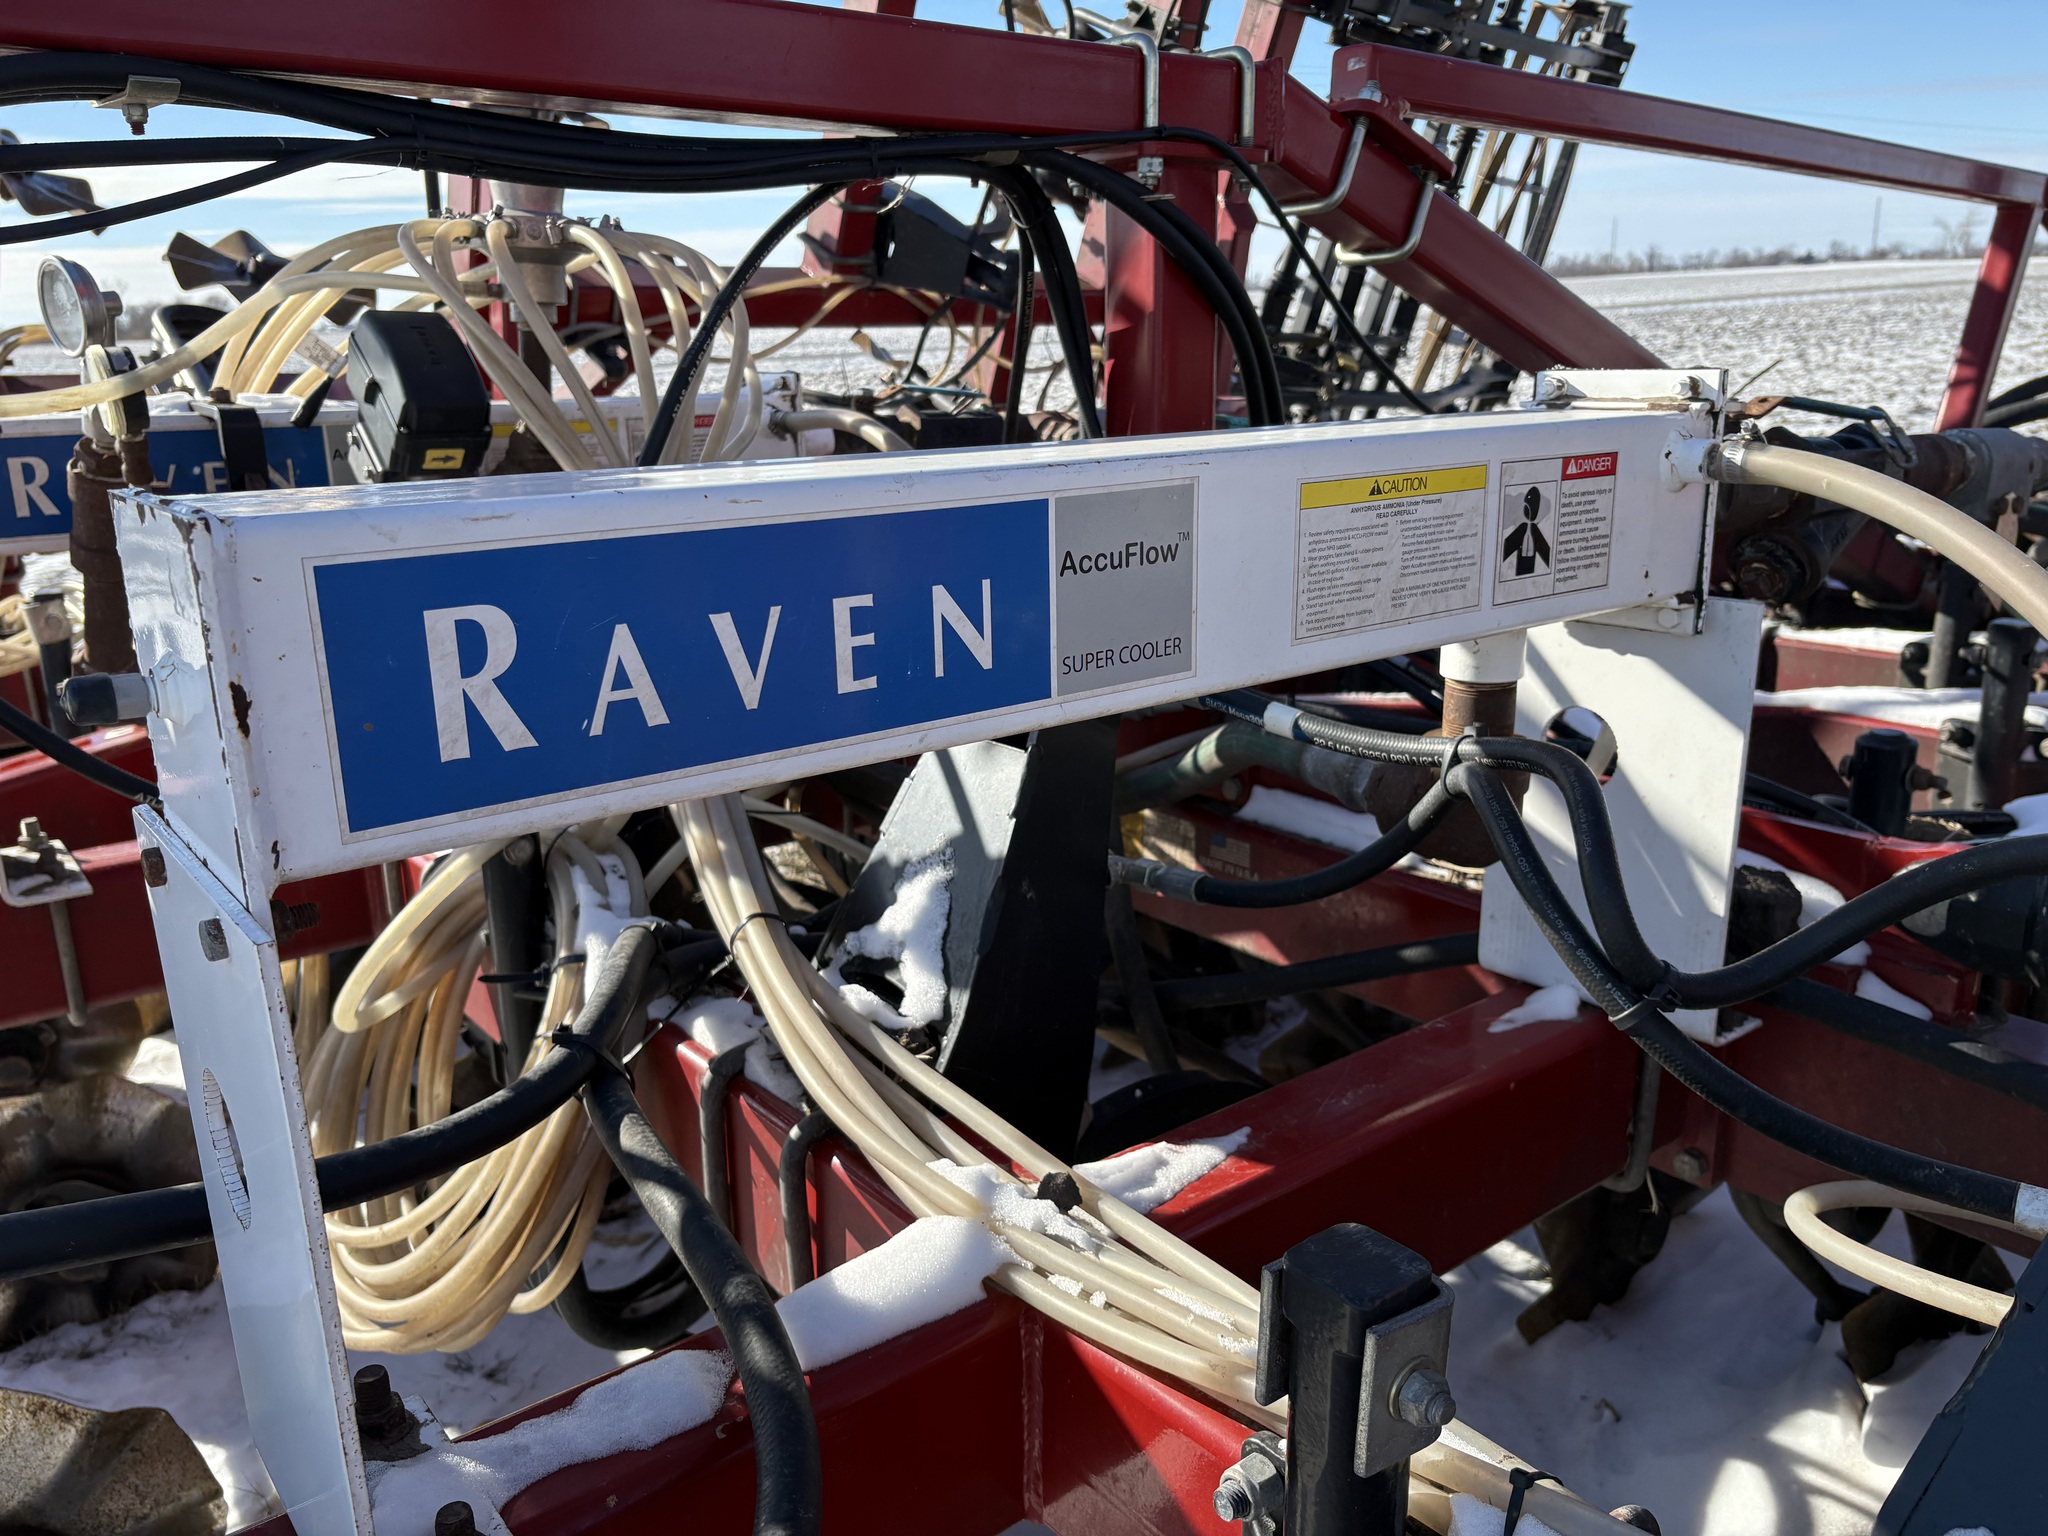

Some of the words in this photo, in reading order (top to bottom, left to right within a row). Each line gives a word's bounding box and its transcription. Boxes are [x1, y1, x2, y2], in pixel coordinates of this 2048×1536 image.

[1576, 456, 1612, 473] DANGER
[1382, 476, 1427, 494] CAUTION
[1580, 489, 1595, 497] serious
[1595, 487, 1607, 496] injury
[1350, 504, 1381, 513] ANHYDROUS
[1382, 501, 1404, 510] AMMONIA
[1405, 499, 1420, 508] (Under
[1420, 497, 1442, 506] Pressure)
[1375, 511, 1389, 519] READ
[1389, 508, 1417, 517] CAREFULLY
[1062, 648, 1115, 675] SUPER
[1119, 637, 1182, 665] COOLER
[423, 579, 993, 763] RAVEN
